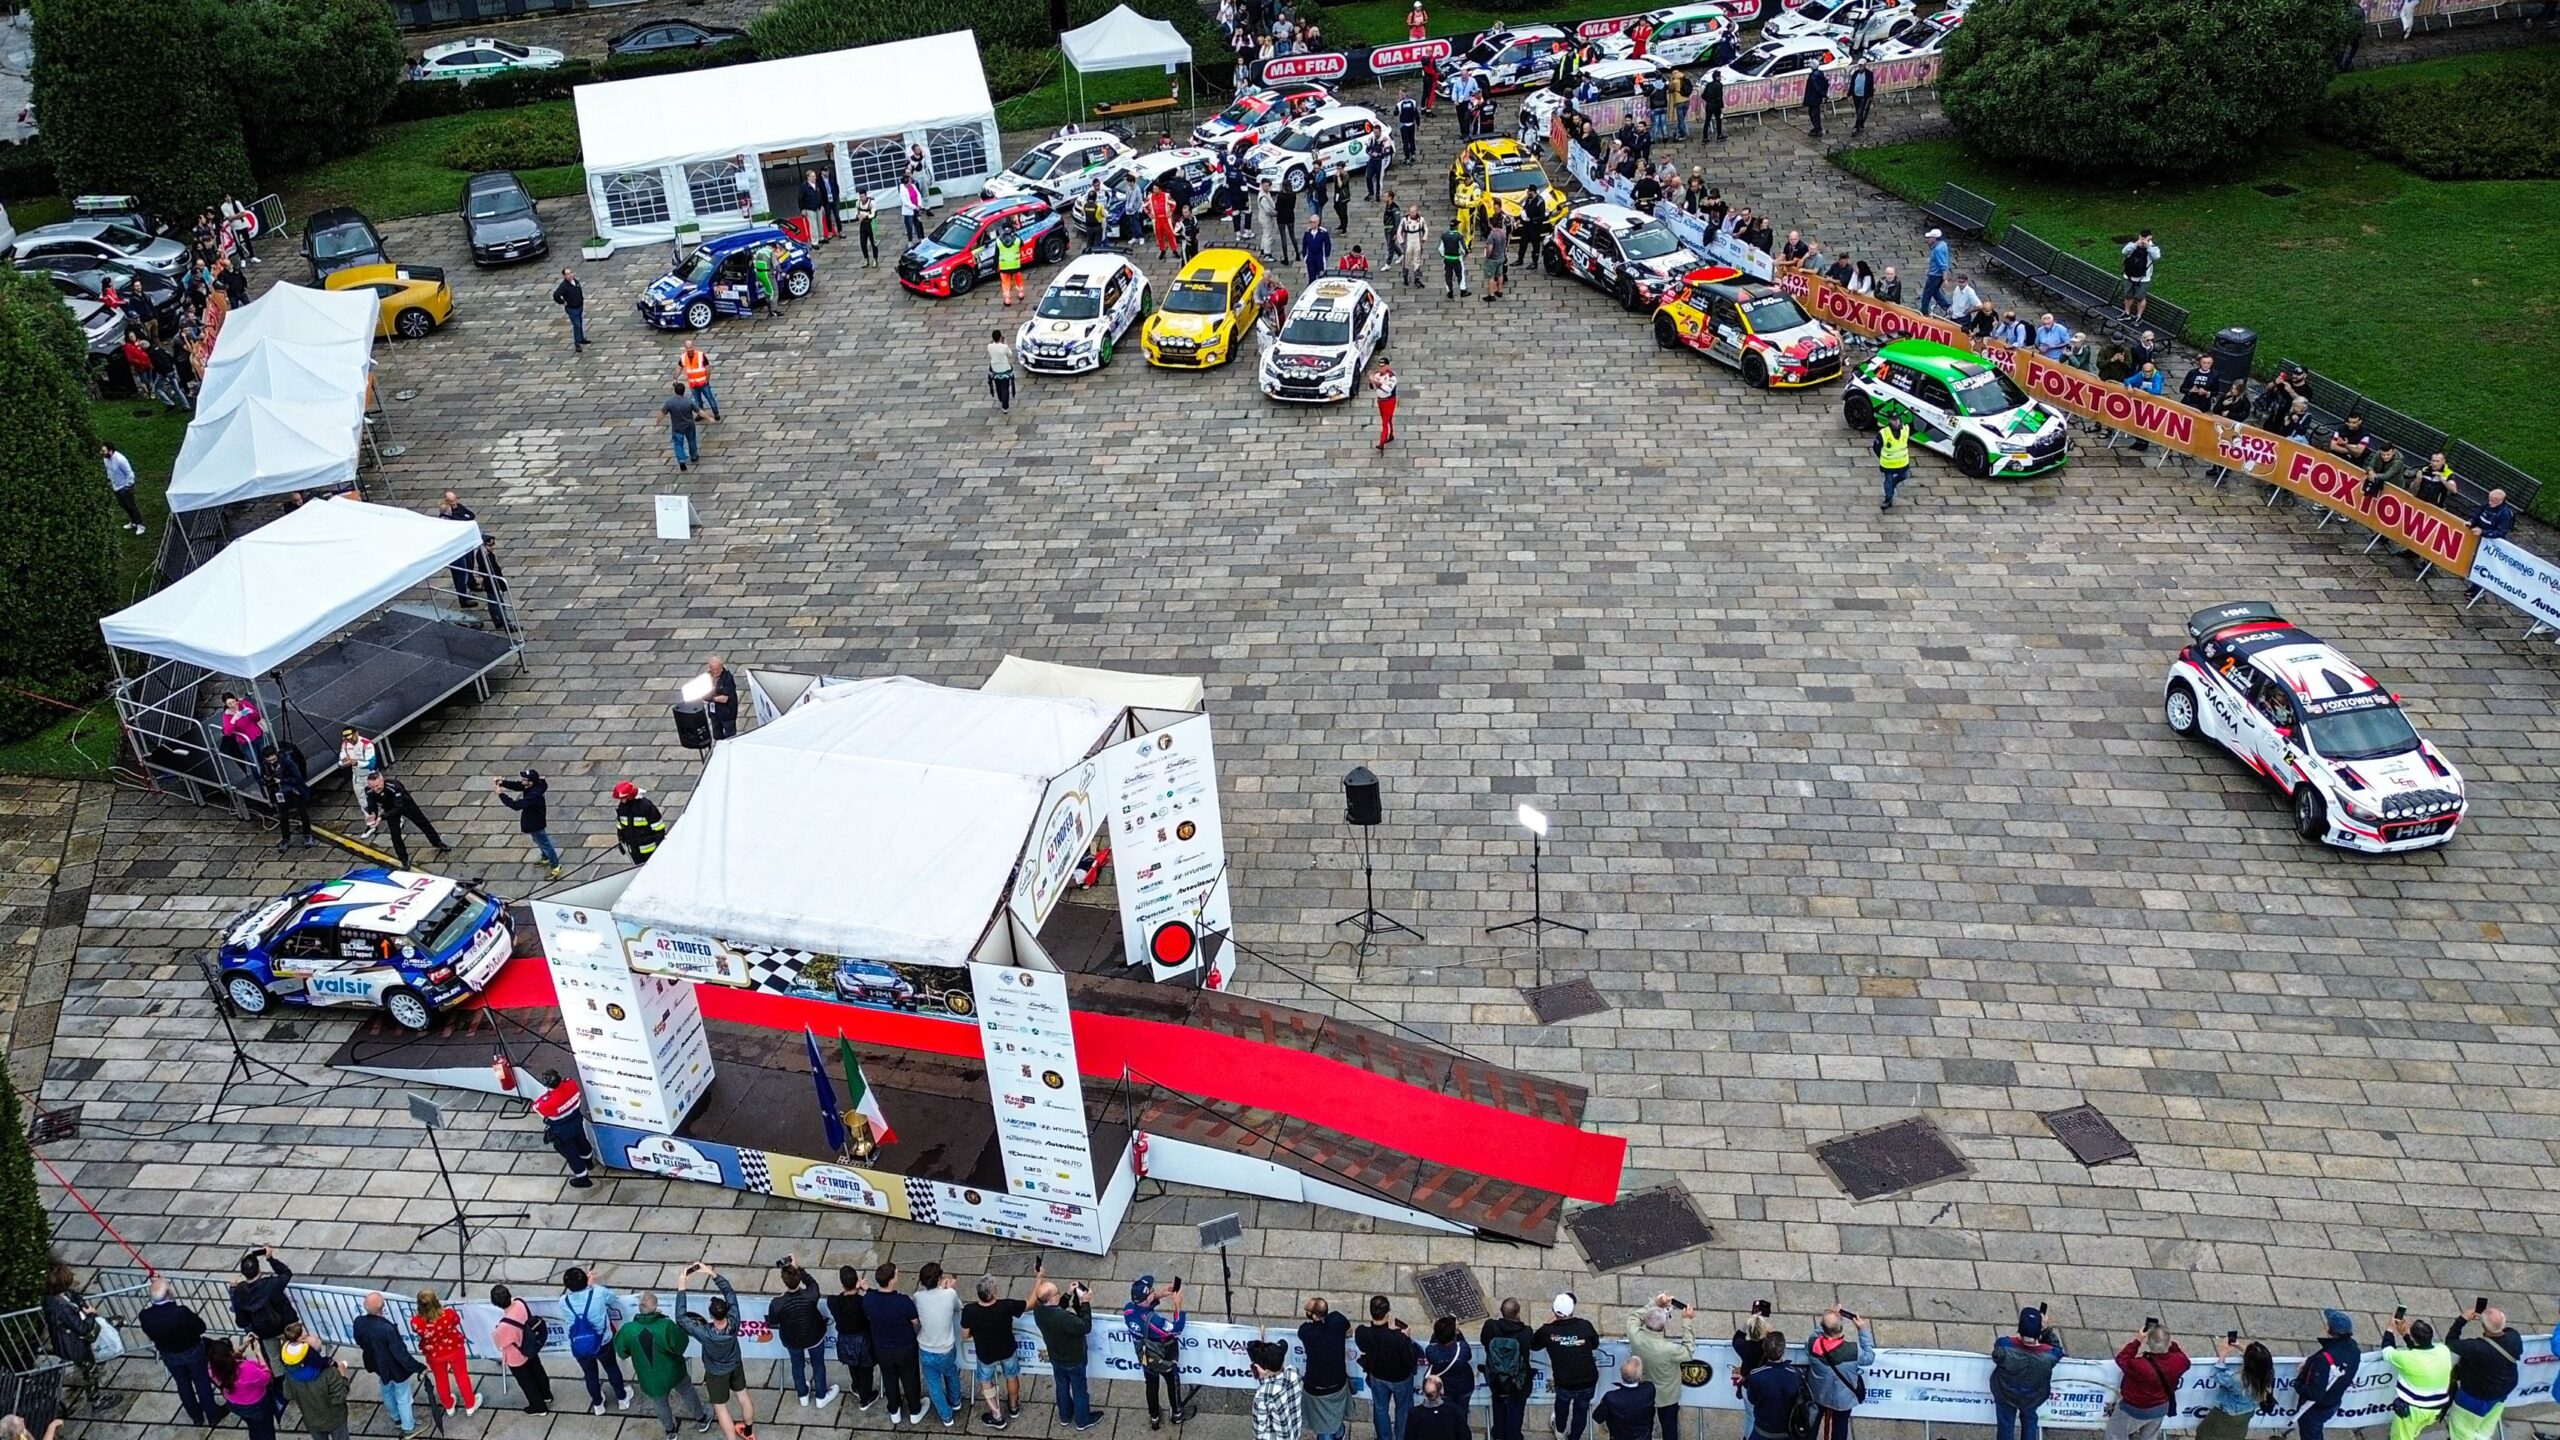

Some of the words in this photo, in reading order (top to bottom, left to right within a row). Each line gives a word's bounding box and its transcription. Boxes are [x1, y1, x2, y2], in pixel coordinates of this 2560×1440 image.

[1568, 245, 1590, 270] ASD
[1787, 273, 1809, 289] FOX
[1781, 283, 1809, 298] OWN
[1988, 347, 2015, 363] FOX
[2027, 362, 2193, 444] FOXTOWN
[2241, 434, 2278, 454] FOX
[2218, 443, 2275, 466] TOWN
[2483, 544, 2534, 577] AUTOTORINO
[2480, 565, 2528, 599] Clericiauto
[2221, 607, 2250, 618] HMI
[2235, 631, 2282, 644] SACMA
[2219, 656, 2236, 675] 2
[2204, 686, 2239, 735] SACMA
[2322, 696, 2374, 711] FOXTOWN
[2286, 753, 2295, 764] 2
[2396, 821, 2437, 838] HMI
[657, 938, 671, 951] 42
[672, 940, 711, 956] TROFEO
[313, 977, 372, 994] valsir
[869, 989, 892, 999] HMI
[815, 1175, 828, 1186] 42
[828, 1177, 861, 1191] TROFEO
[741, 1320, 770, 1329] FOX
[737, 1329, 771, 1337] OWN
[1869, 1369, 1950, 1382] HYUNDAI
[2348, 1372, 2393, 1390] AUTO
[1864, 1388, 1893, 1398] FIERE
[1930, 1395, 1981, 1404] Espansione
[2063, 1393, 2103, 1403] TROFEO
[2336, 1402, 2396, 1418] tovitta
